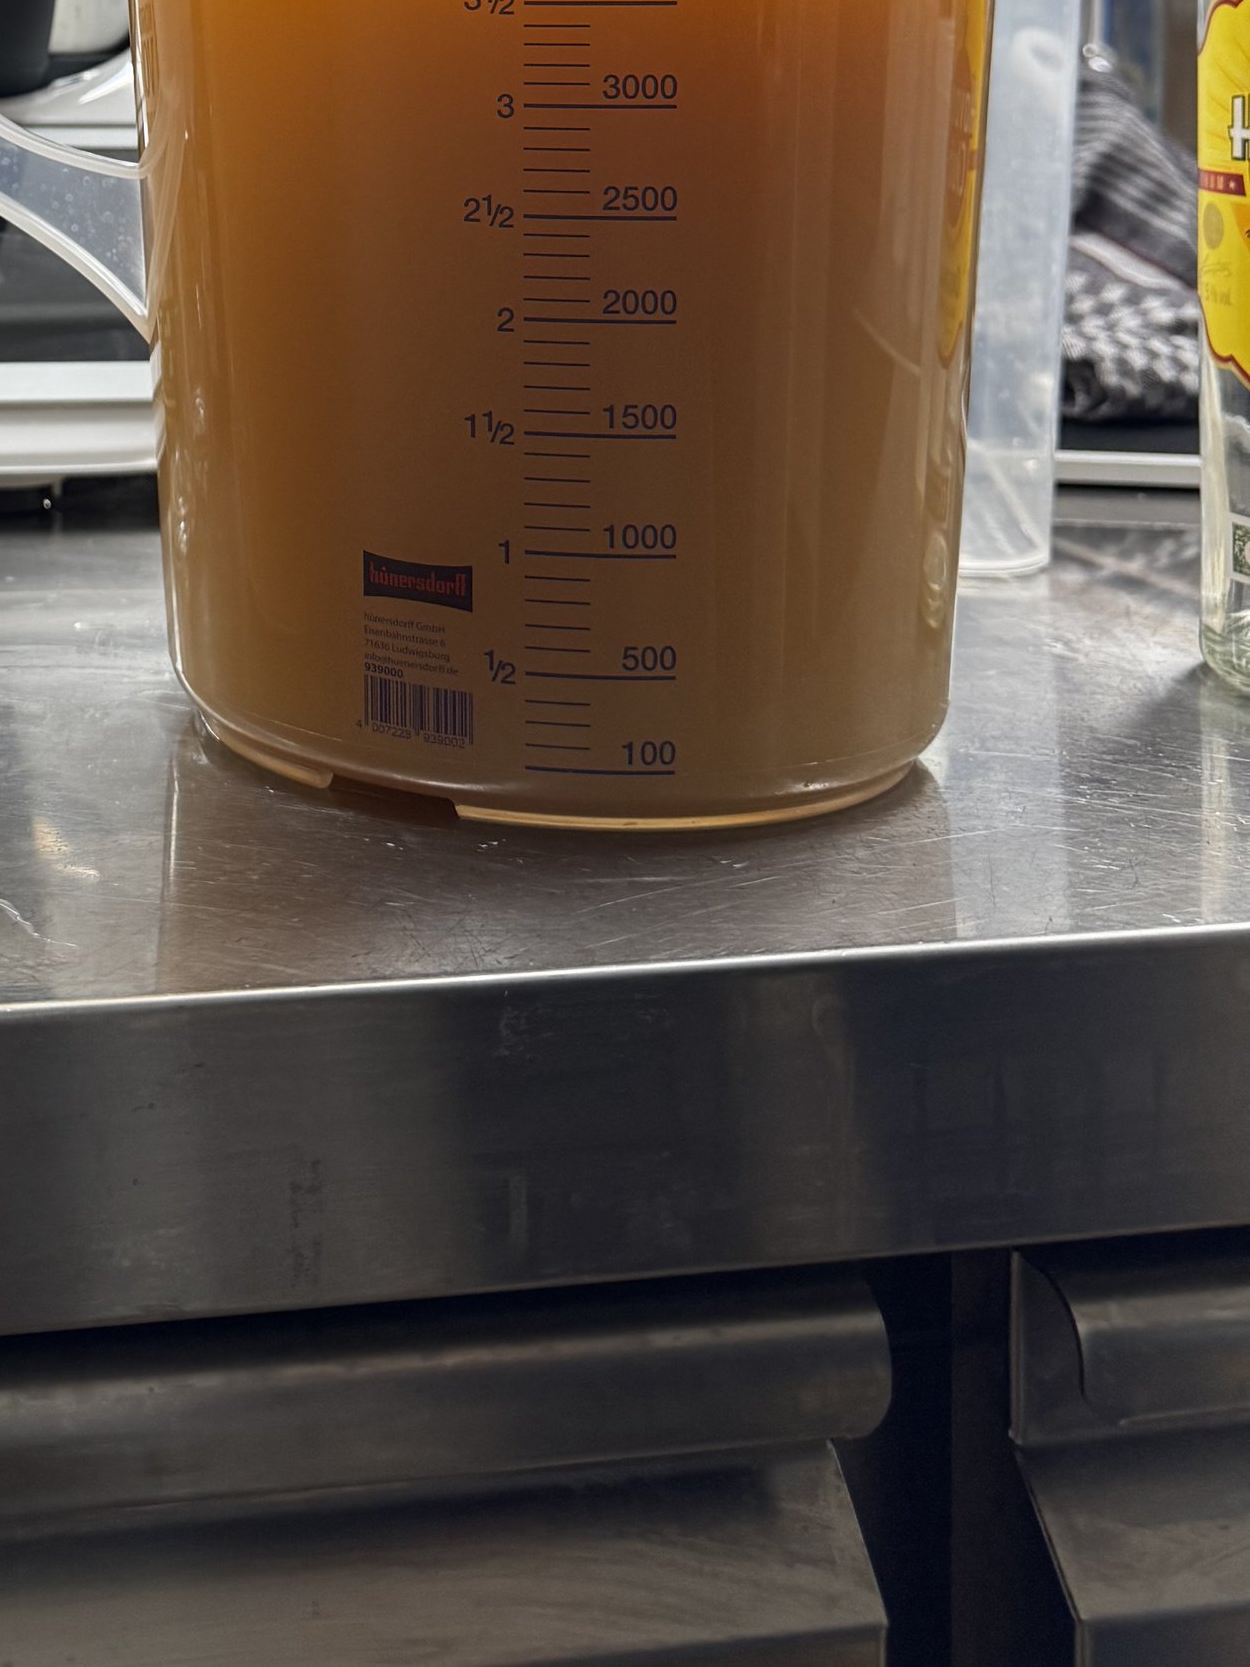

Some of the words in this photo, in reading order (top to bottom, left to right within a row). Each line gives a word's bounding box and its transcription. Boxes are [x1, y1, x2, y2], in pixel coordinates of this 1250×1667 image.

[602, 74, 678, 100] 3000
[497, 93, 515, 119] 3
[602, 186, 678, 212] 2500
[602, 289, 677, 315] 2000
[497, 307, 515, 332] 2
[602, 404, 677, 430] 1500
[603, 524, 677, 549] 1000
[498, 540, 510, 565] 1
[364, 662, 404, 679] 939000
[622, 646, 677, 671] 500
[622, 741, 676, 766] 100
